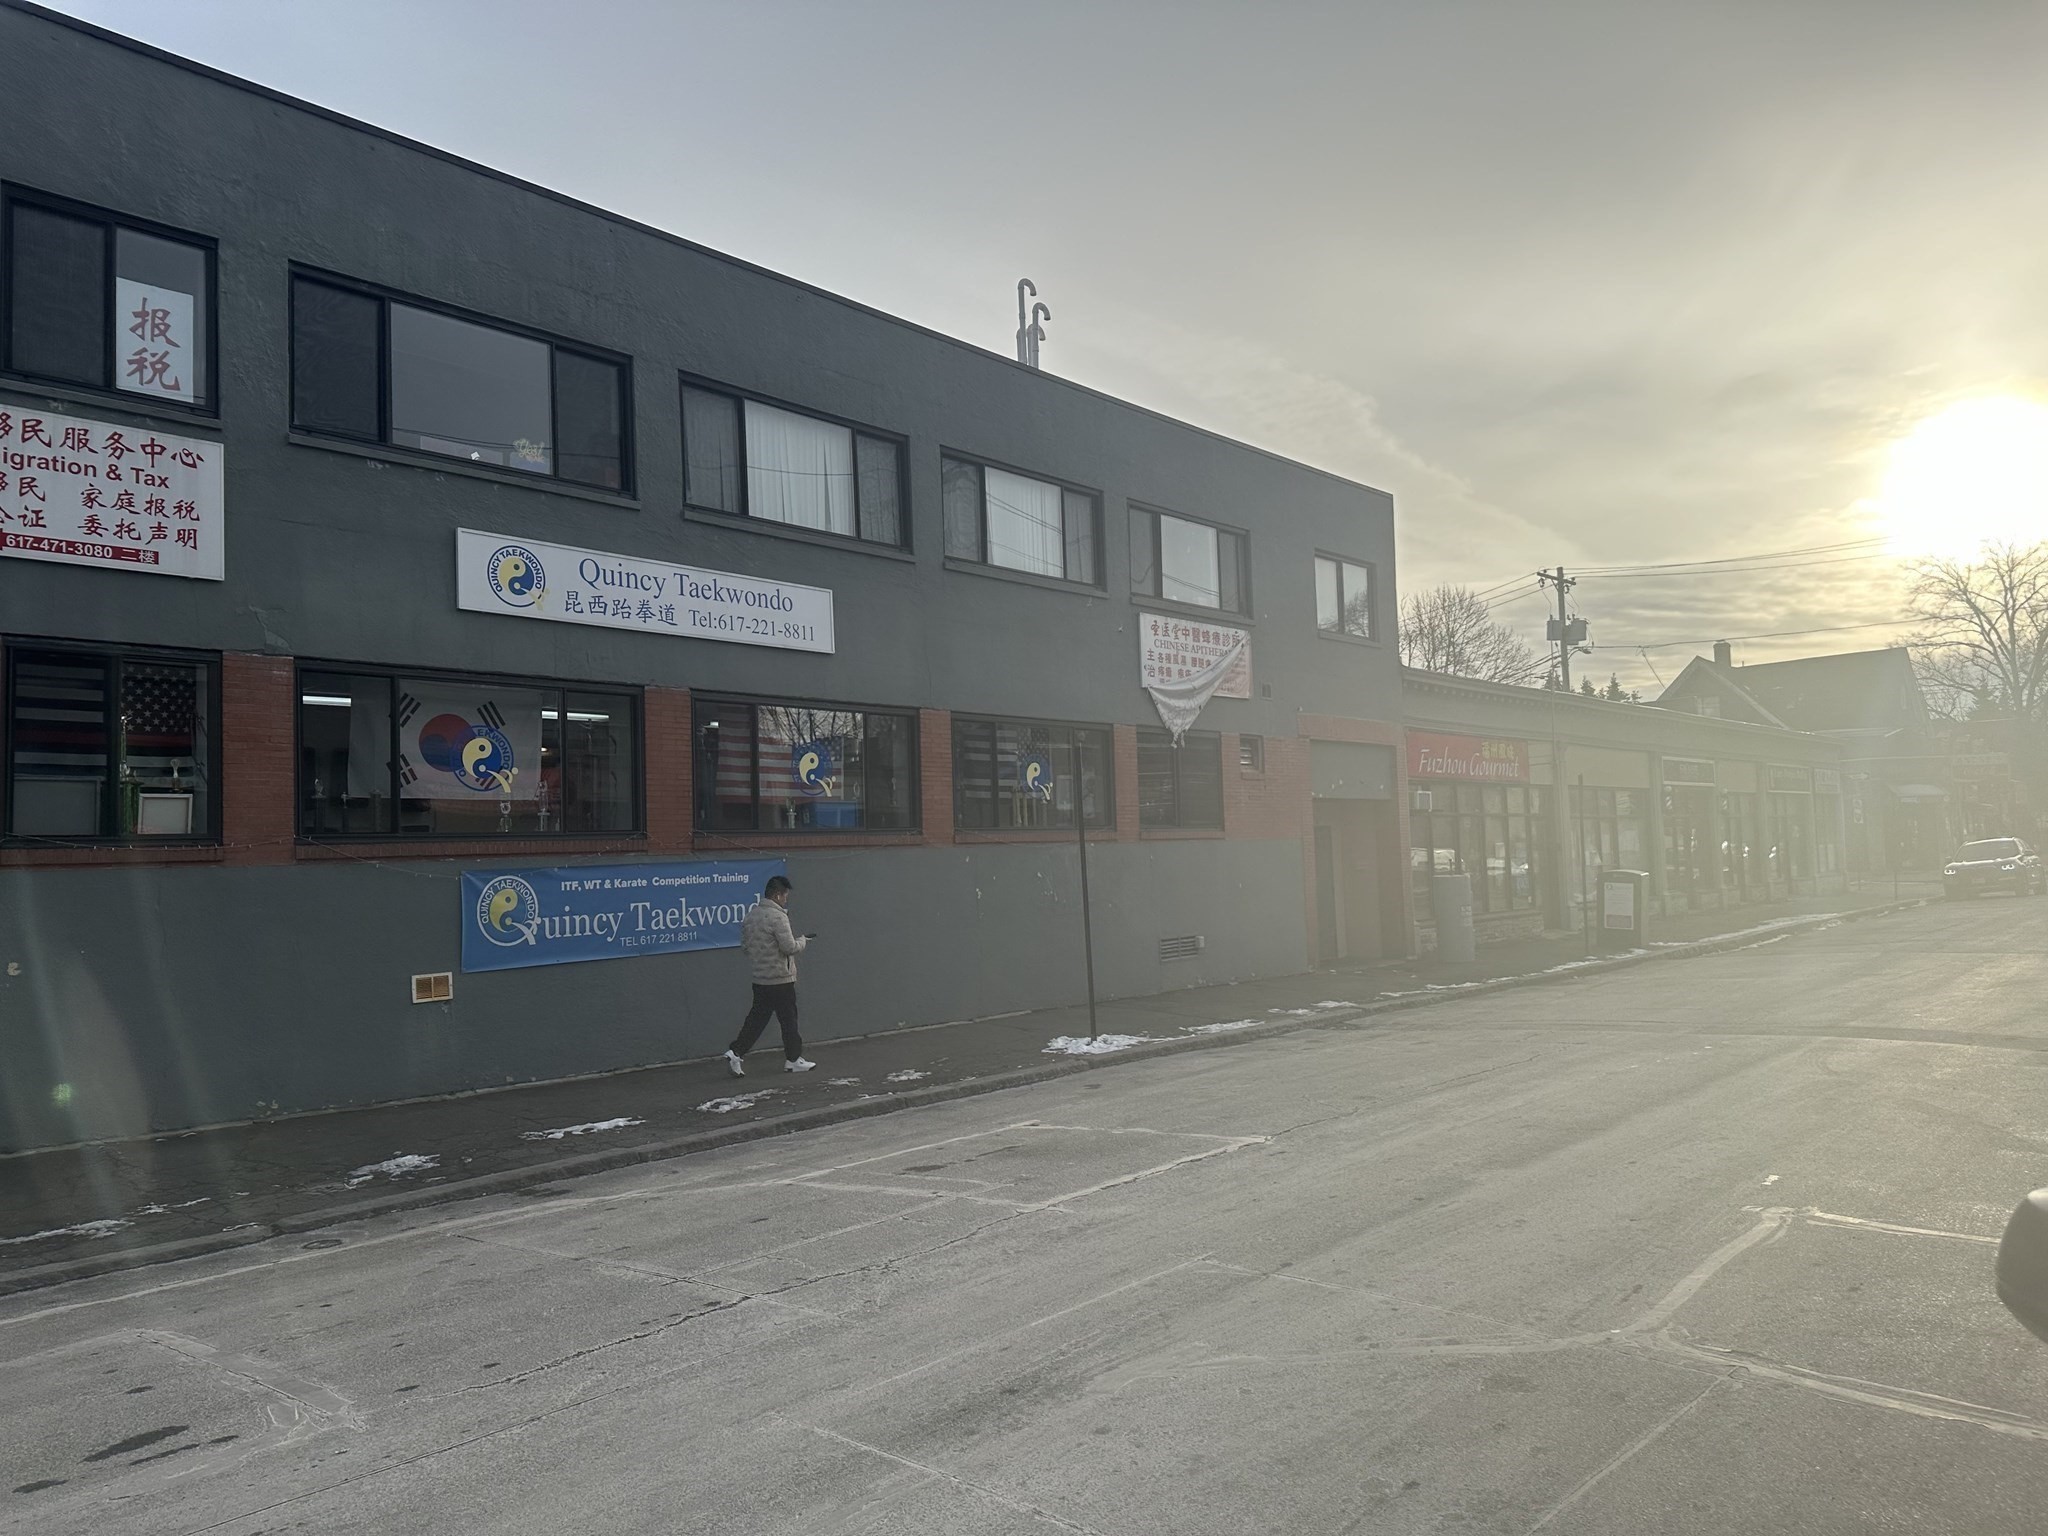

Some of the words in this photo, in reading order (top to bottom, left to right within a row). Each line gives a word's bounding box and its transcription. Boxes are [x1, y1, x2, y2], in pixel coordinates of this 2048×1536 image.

[126, 297, 181, 392] 报税
[3, 447, 97, 478] igration
[105, 464, 123, 482] &
[130, 467, 170, 489] Tax
[80, 483, 201, 522] 家庭报税
[6, 534, 113, 559] 617-471-3080
[78, 513, 199, 551] 委托声明
[490, 555, 503, 593] QUINCY
[499, 548, 543, 590] TAEKWONDO
[579, 558, 667, 599] Quincy
[673, 572, 793, 613] Taekwondo
[564, 590, 678, 626] 昆西跆拳道
[688, 609, 815, 642] Tel:617-221-8811
[1153, 638, 1189, 653] CHINESE
[1418, 747, 1467, 775] Fuzhou
[1469, 752, 1520, 778] Gourmet
[480, 887, 495, 924] QUINCY
[494, 879, 535, 919] TAEKWONDO
[560, 881, 582, 892] ITF,
[583, 880, 602, 890] WT
[604, 879, 612, 889] &
[614, 878, 648, 888] Karate
[651, 875, 711, 887] Competition
[712, 872, 750, 884] Training
[620, 937, 638, 947] TEL
[640, 934, 657, 945] 617
[659, 933, 676, 943] 221
[678, 931, 698, 942] 8811
